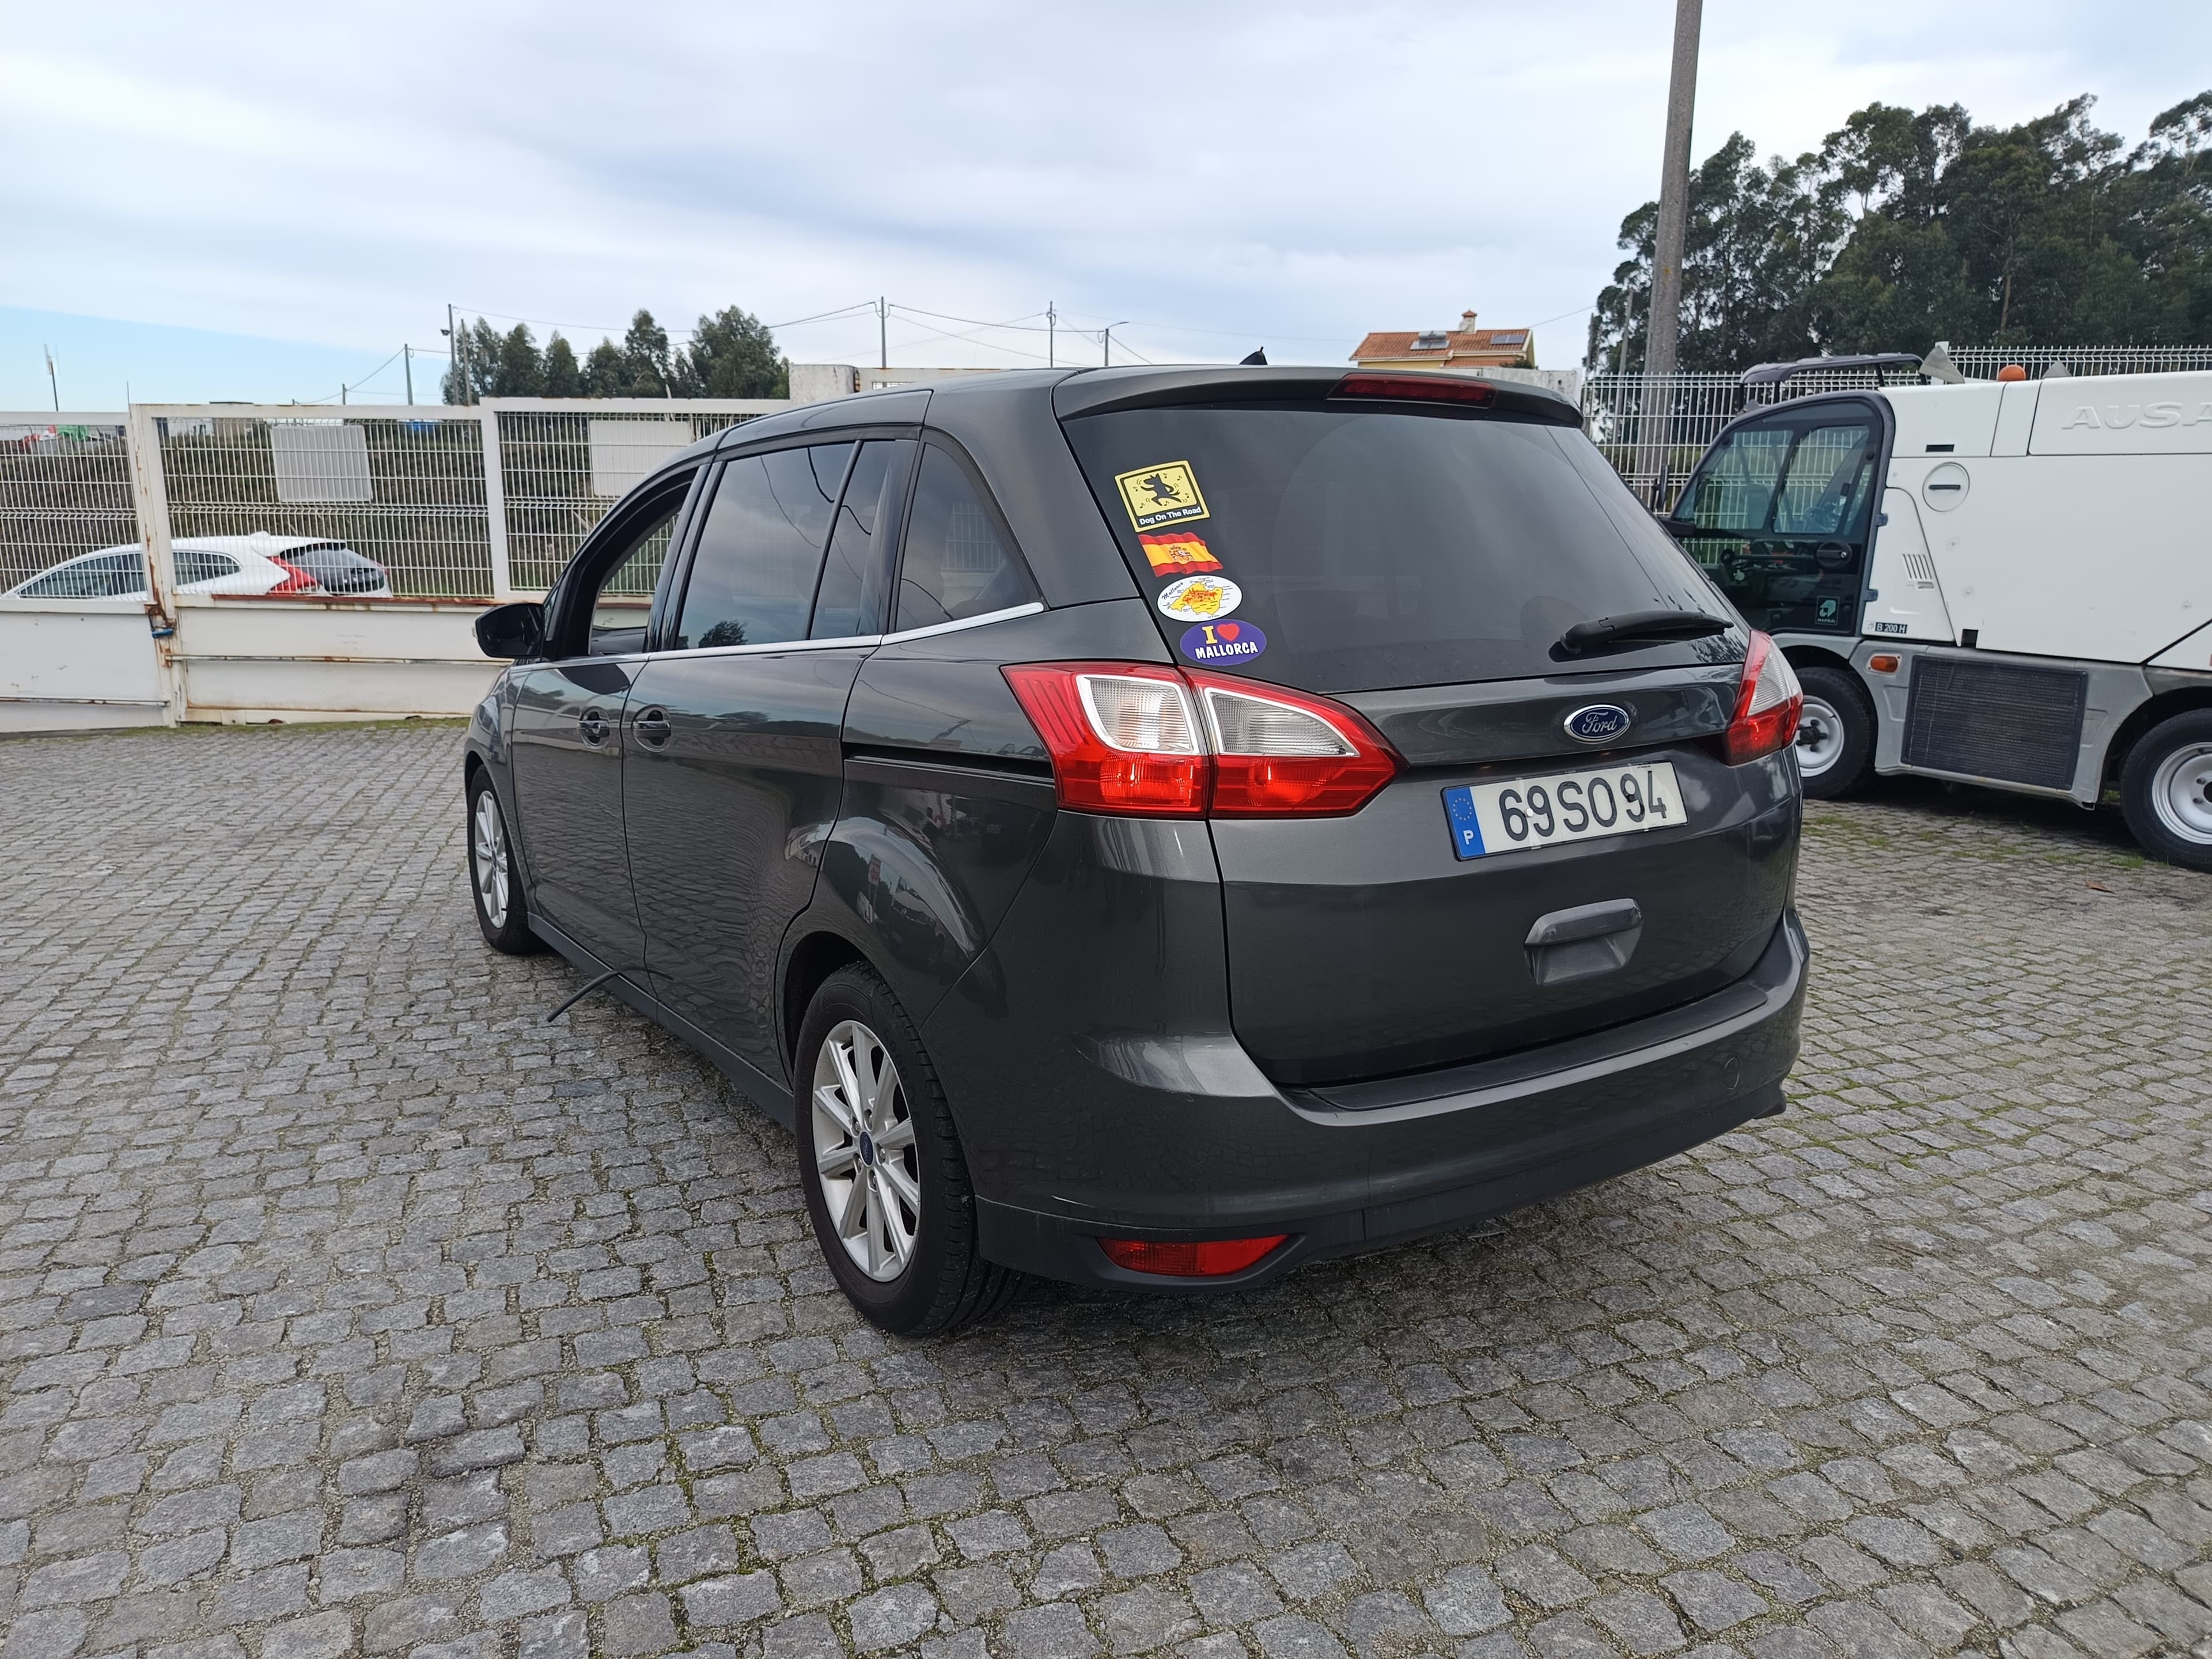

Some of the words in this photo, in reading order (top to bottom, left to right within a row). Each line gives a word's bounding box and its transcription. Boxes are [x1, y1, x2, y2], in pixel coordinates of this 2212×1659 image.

[2061, 401, 2212, 429] AUSA
[1139, 518, 1156, 526] Dog
[1181, 506, 1202, 516] Road
[1161, 582, 1184, 600] Mallorca
[1202, 625, 1218, 645] I
[1876, 623, 1883, 632] B
[1884, 624, 1898, 632] 200
[1899, 625, 1906, 634] H
[1195, 641, 1259, 660] MALLORCA
[1581, 711, 1618, 734] Ford
[1463, 830, 1475, 845] P
